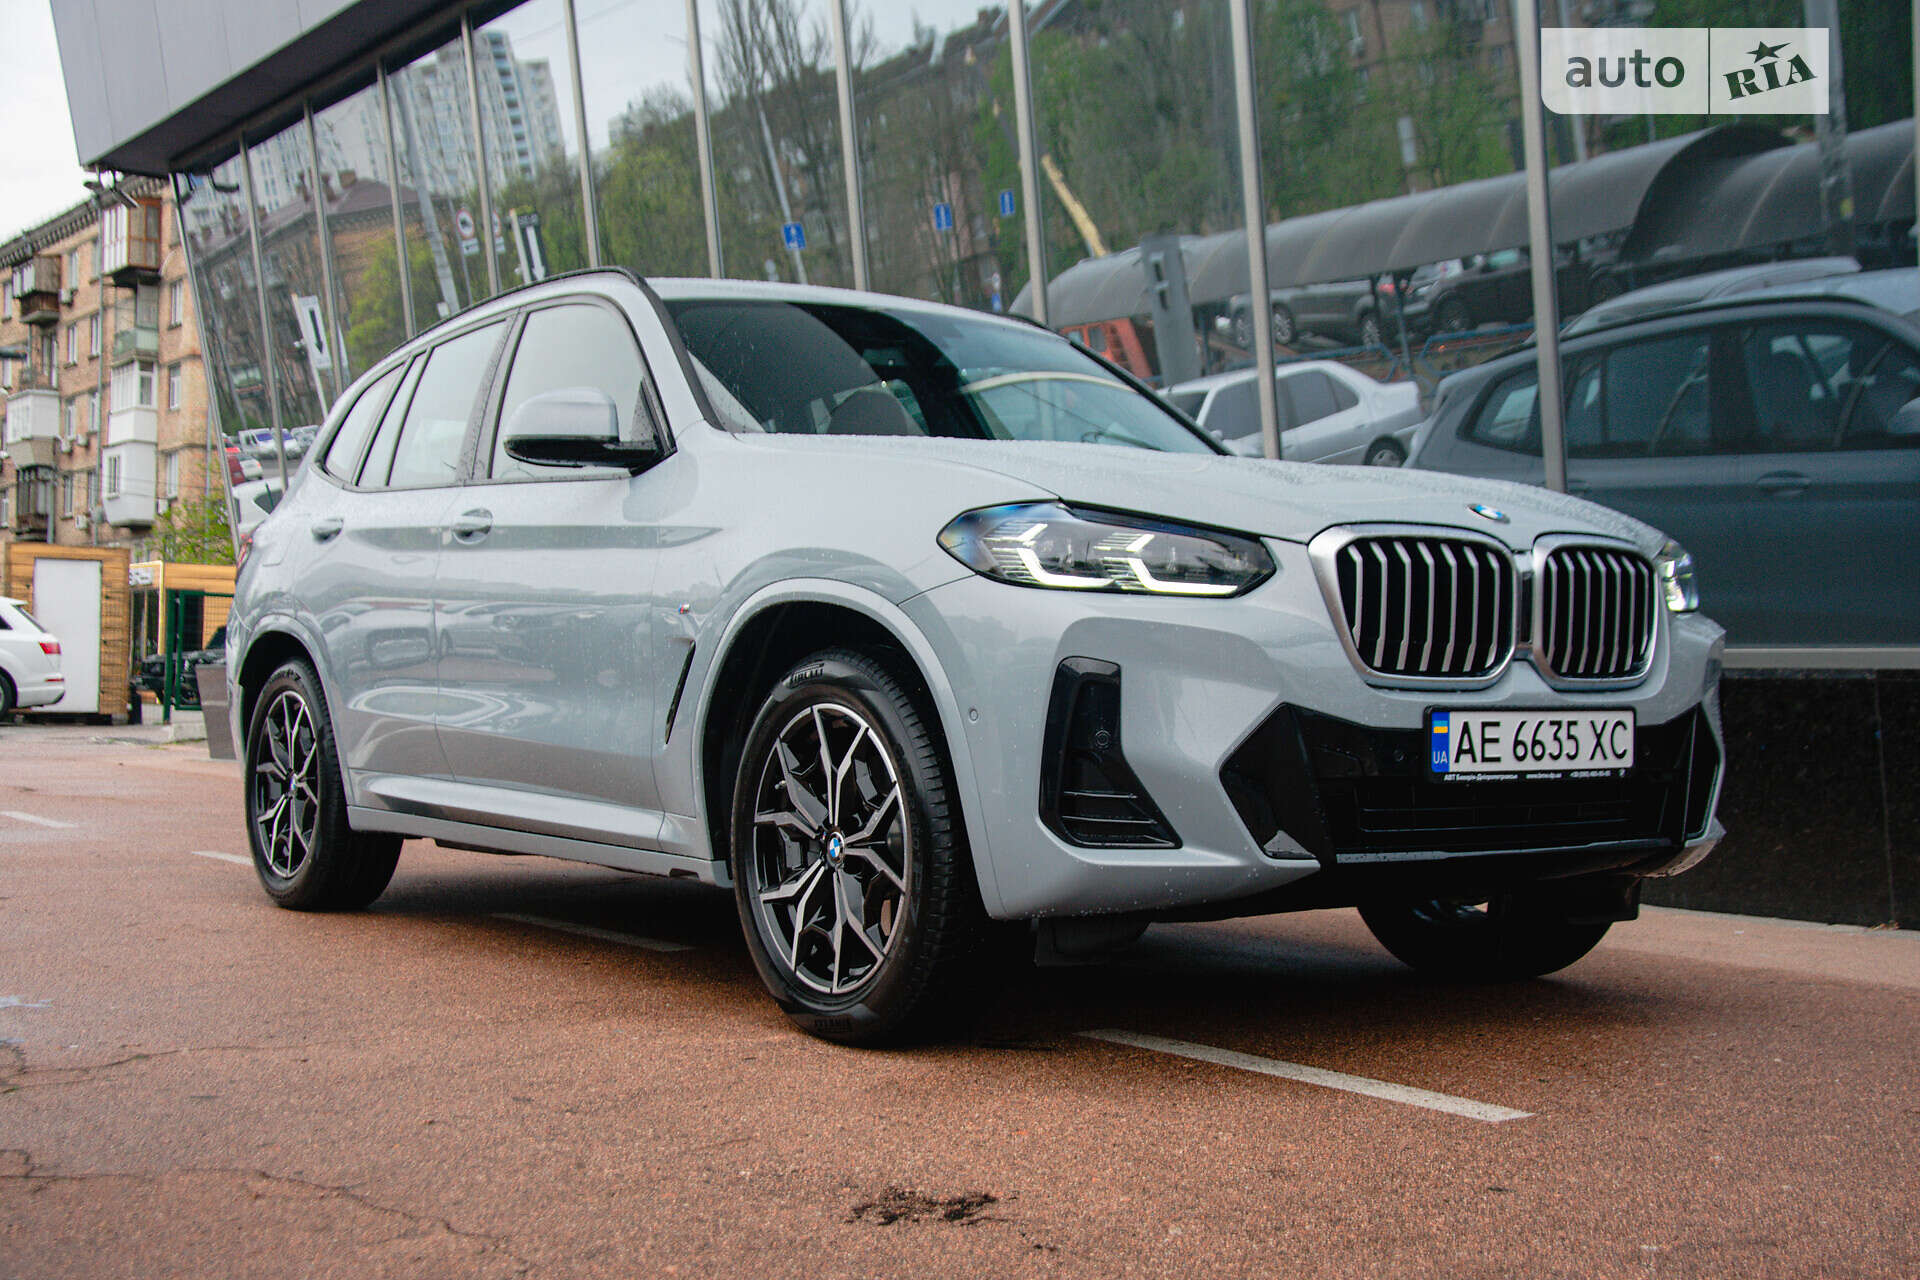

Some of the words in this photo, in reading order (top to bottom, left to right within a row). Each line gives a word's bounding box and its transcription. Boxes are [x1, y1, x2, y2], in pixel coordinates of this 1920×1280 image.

[1454, 721, 1502, 764] AE
[1512, 719, 1580, 762] 6635
[1589, 719, 1628, 761] XC
[1432, 751, 1449, 765] UA
